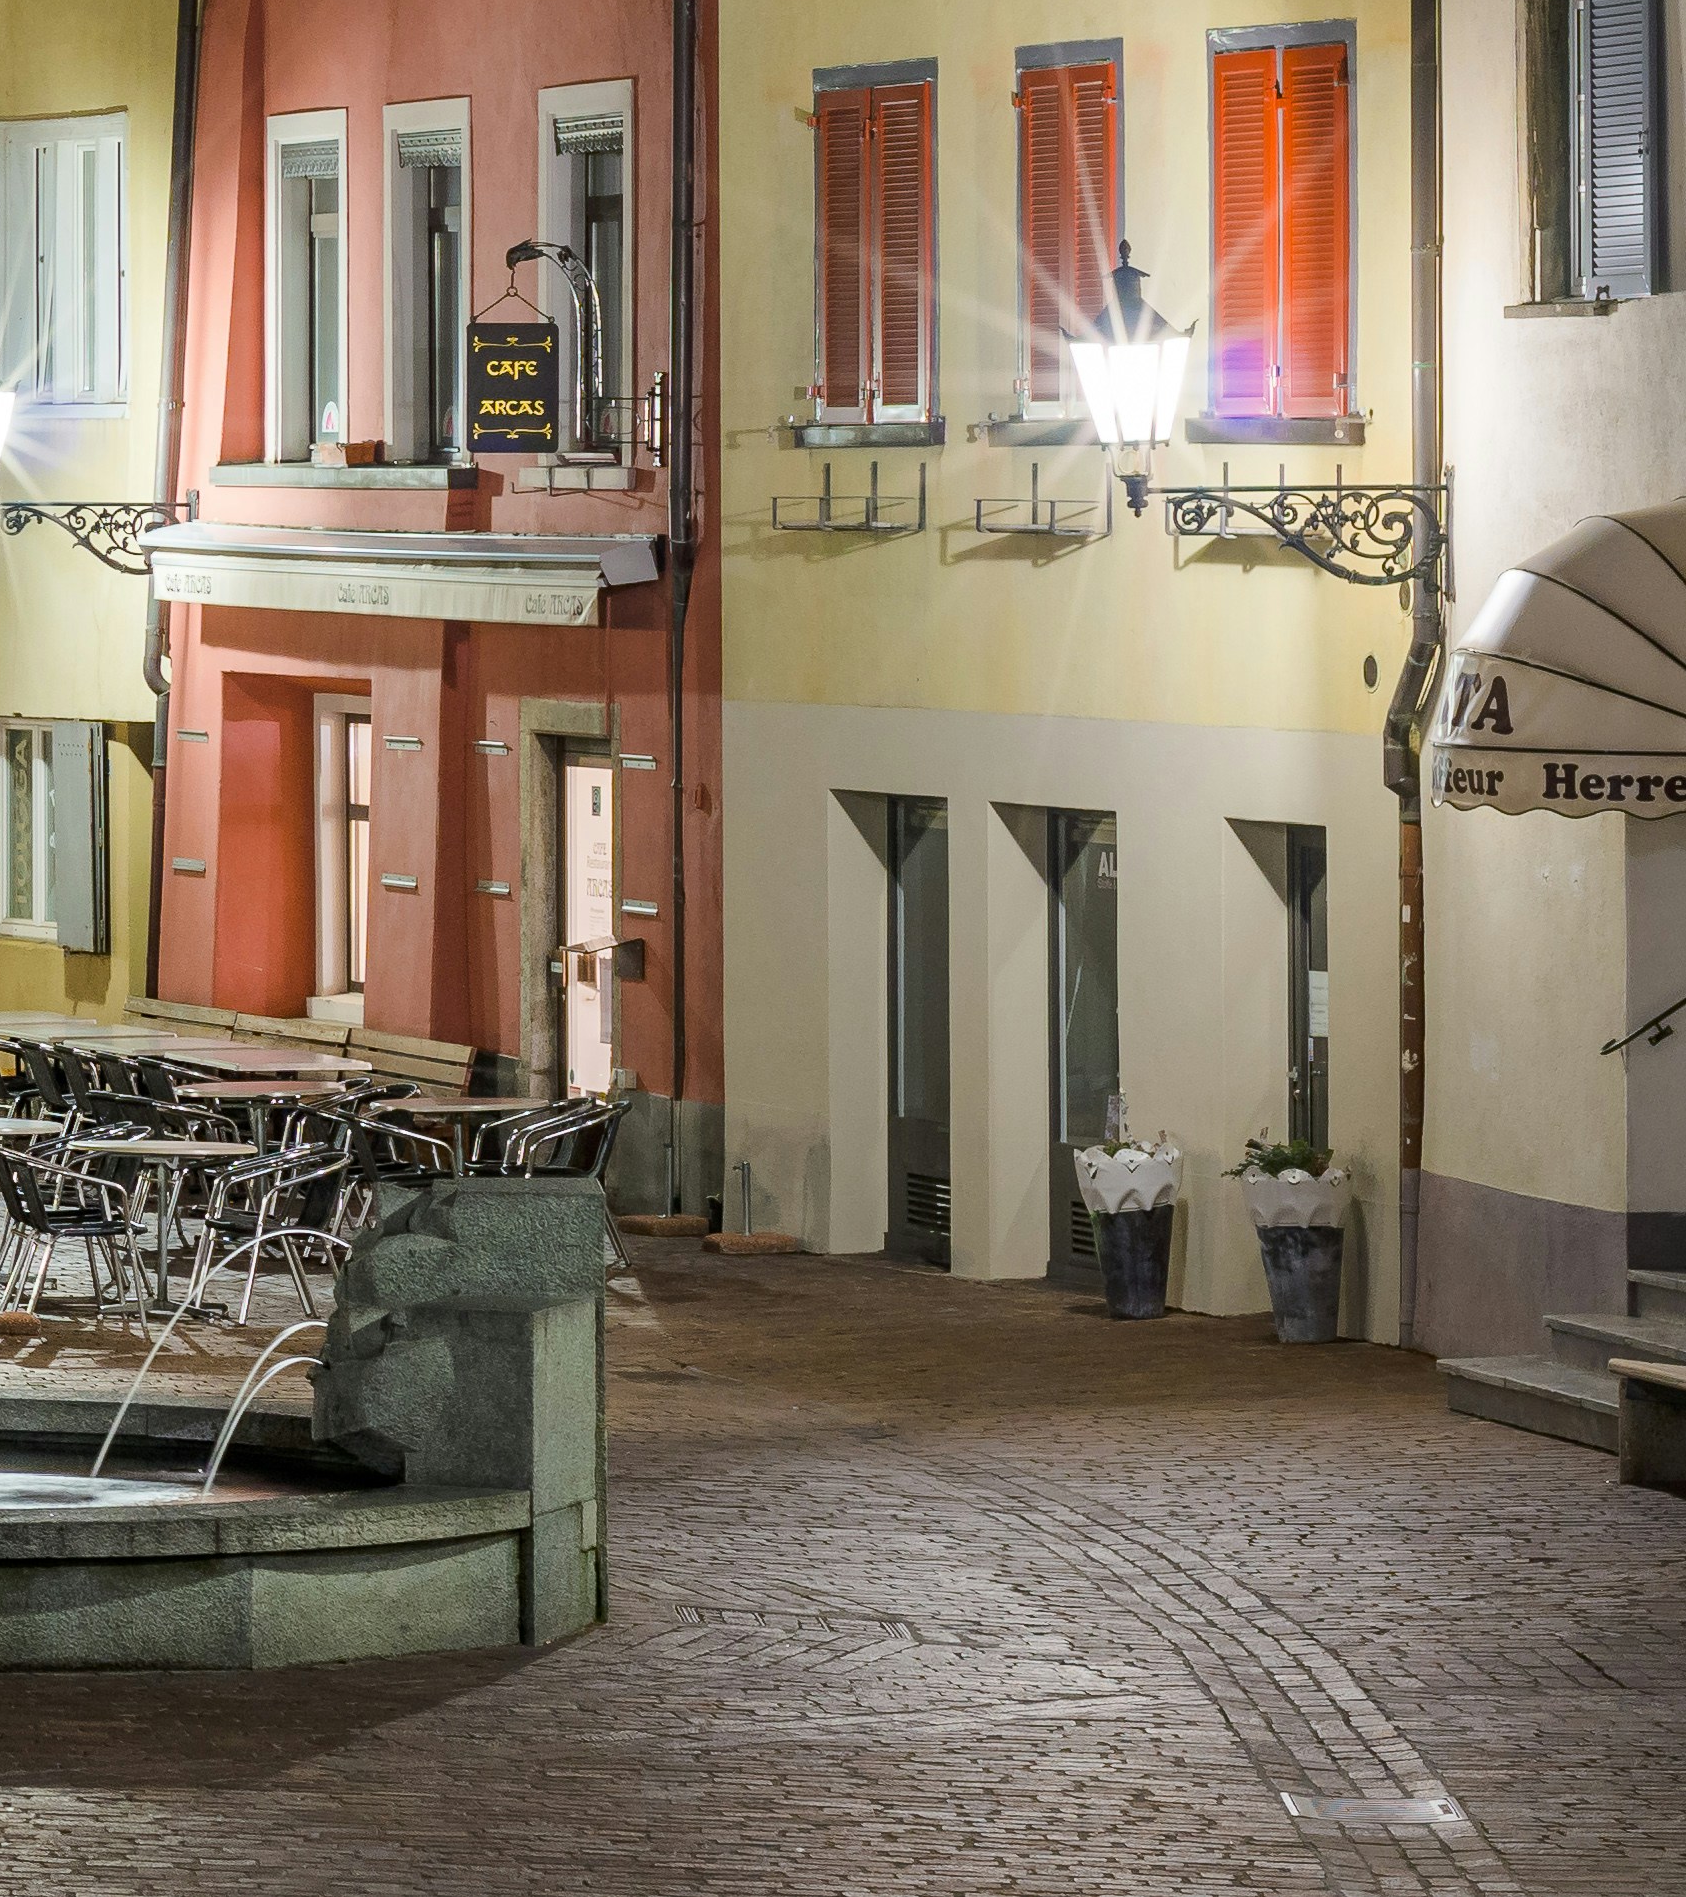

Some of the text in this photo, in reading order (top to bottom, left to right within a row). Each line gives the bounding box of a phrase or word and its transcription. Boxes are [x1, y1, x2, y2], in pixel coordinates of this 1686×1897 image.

[486, 360, 539, 381] CAFE
[479, 399, 545, 416] ARCAS
[358, 584, 389, 606] ARCAS
